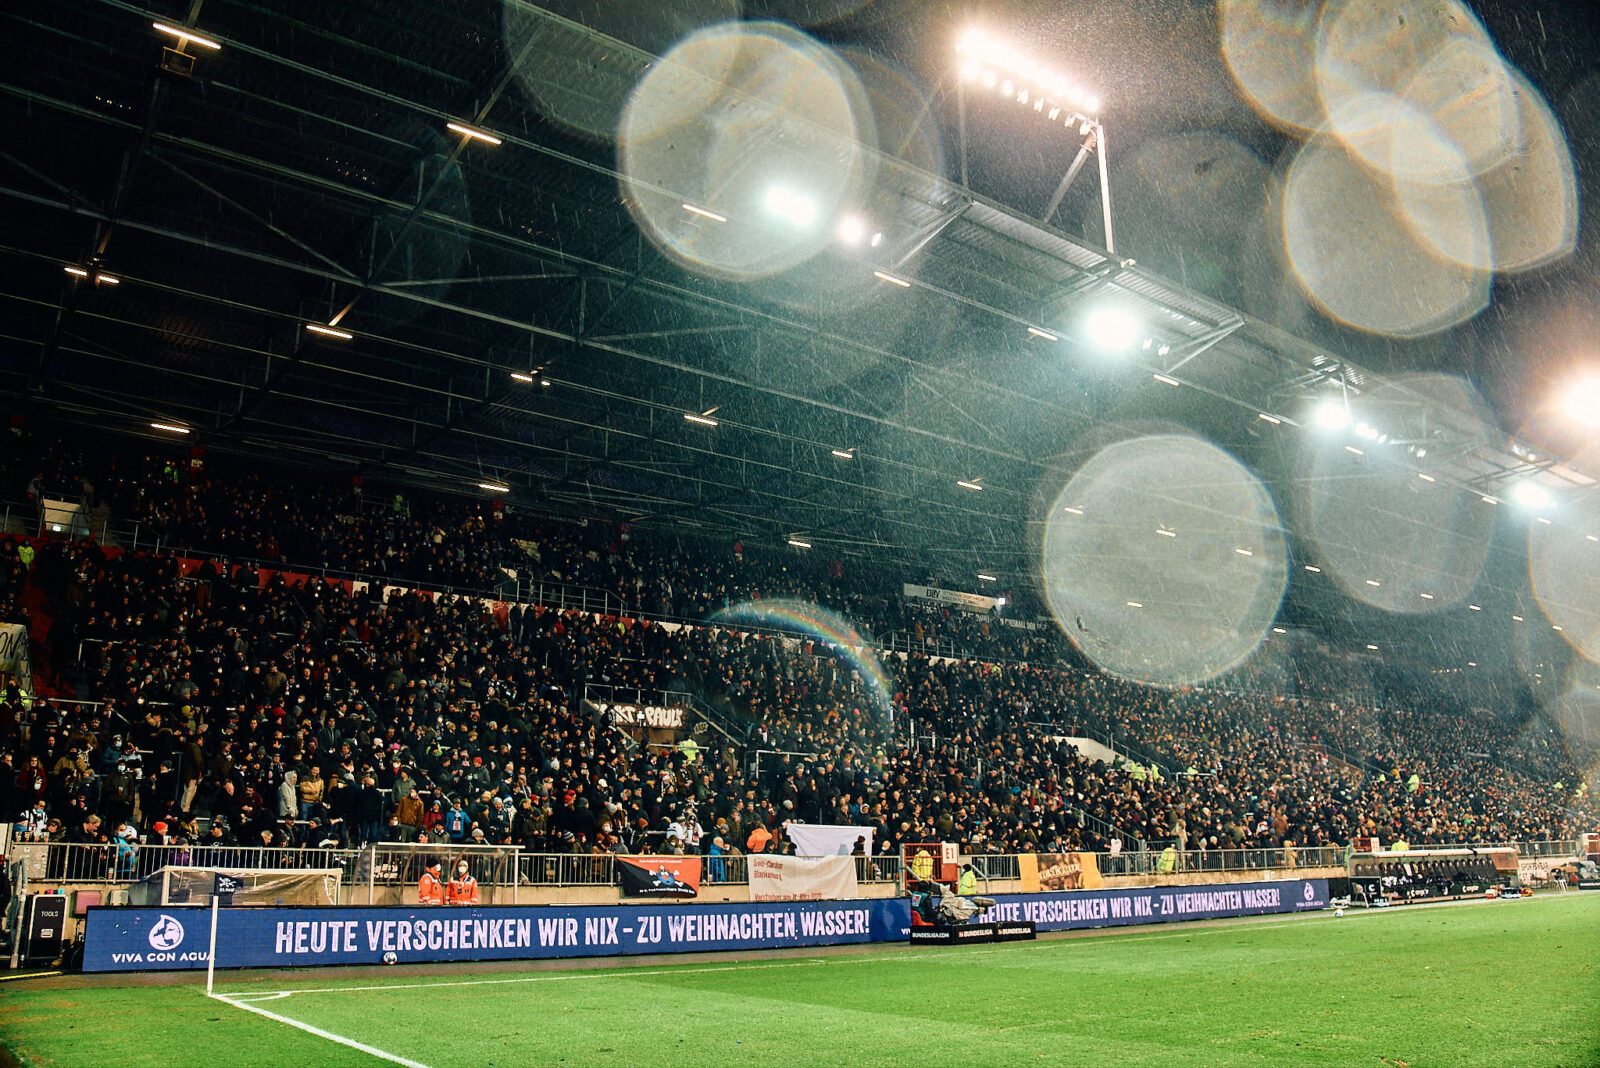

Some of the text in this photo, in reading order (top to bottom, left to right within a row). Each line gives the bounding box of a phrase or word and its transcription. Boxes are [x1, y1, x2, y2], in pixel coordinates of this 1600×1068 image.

[945, 848, 955, 860] E1
[1023, 898, 1108, 923] VERSCHENKEN
[1110, 897, 1132, 918] WIR
[1134, 896, 1153, 917] NIX
[1160, 894, 1174, 915] ZU
[1176, 890, 1242, 914] WEIHNACHTEN
[1243, 888, 1281, 909] WASSER!
[276, 921, 359, 954] HEUTE
[366, 918, 531, 952] VERSCHENKEN
[538, 918, 579, 947] WIR
[585, 917, 619, 946] NIX
[637, 916, 662, 944] ZU
[668, 912, 797, 943] WEIHNACHTEN
[800, 909, 871, 938] WASSER!
[964, 929, 993, 938] BUNDESLIGA
[1002, 927, 1032, 935] BUNDESLIGA
[112, 953, 143, 963] VIVA
[147, 952, 176, 962] CON
